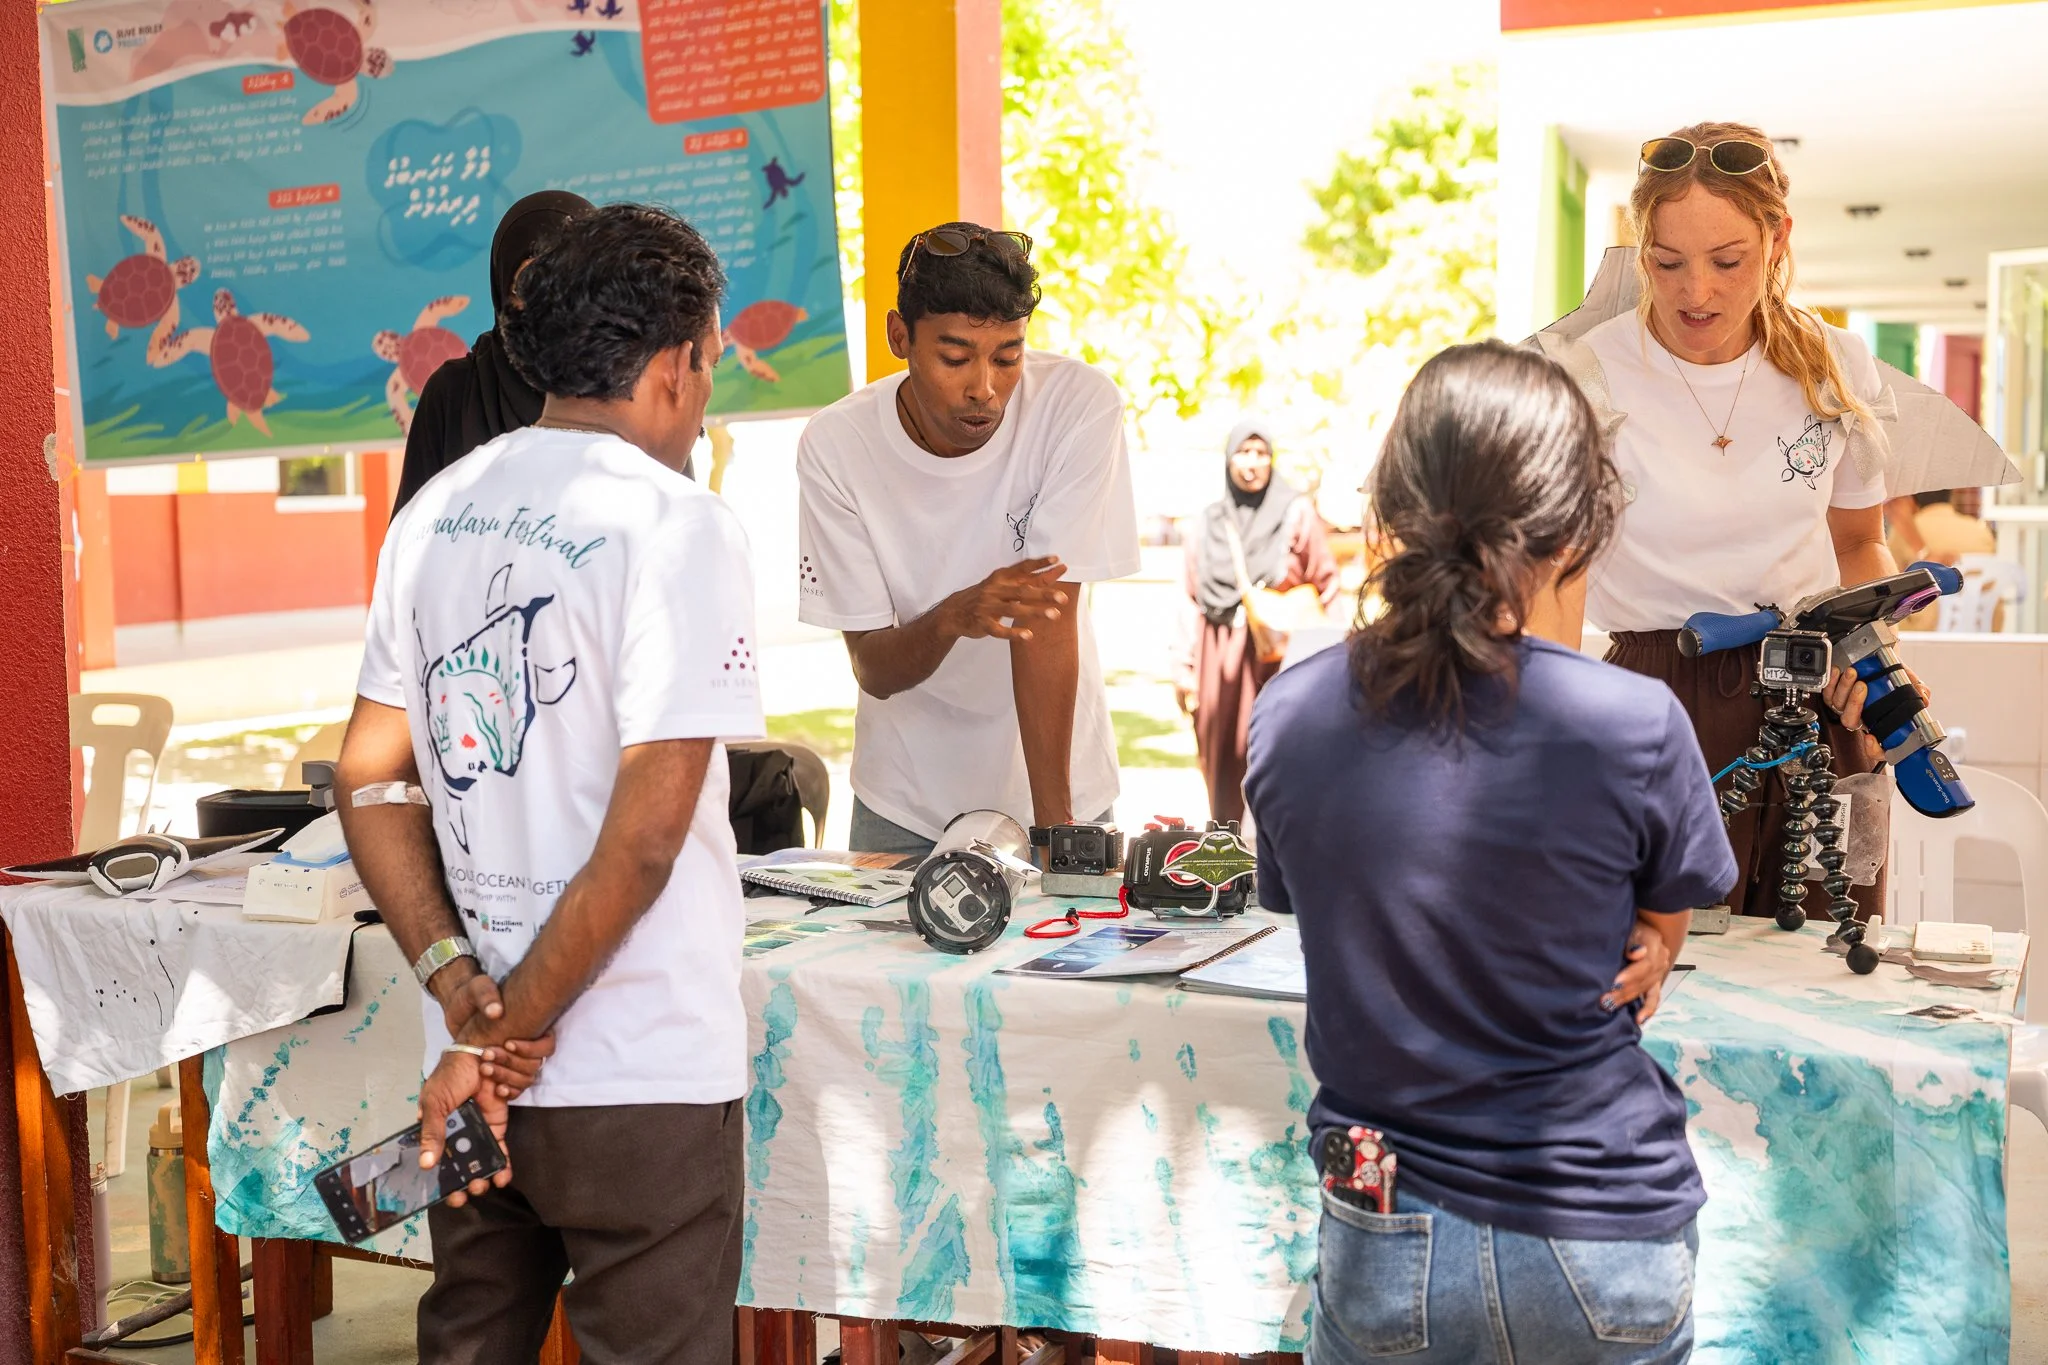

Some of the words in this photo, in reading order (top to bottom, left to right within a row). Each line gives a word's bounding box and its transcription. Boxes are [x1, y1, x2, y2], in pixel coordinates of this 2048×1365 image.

[504, 506, 607, 570] Festival
[1766, 669, 1790, 680] MT2
[1839, 803, 1848, 830] Researc
[1144, 847, 1152, 877] OLYMPUS
[476, 872, 525, 890] OCEAN
